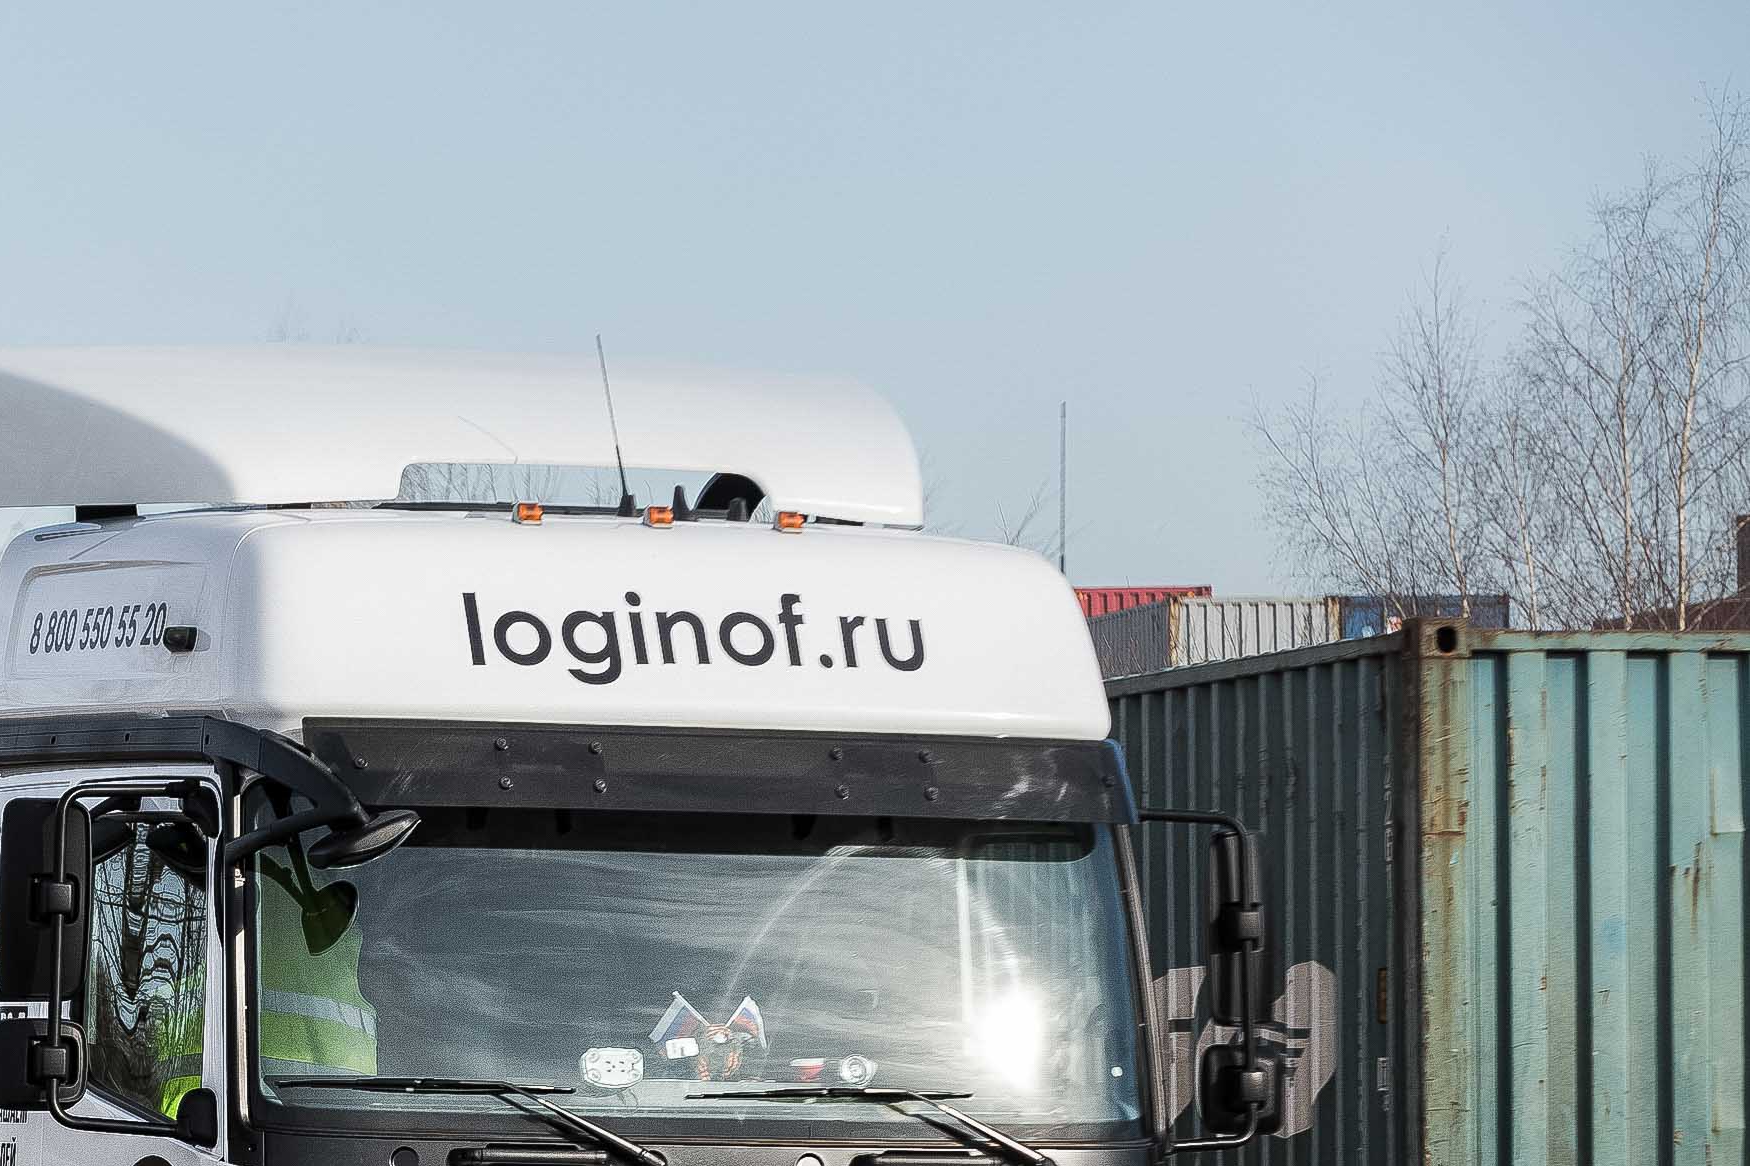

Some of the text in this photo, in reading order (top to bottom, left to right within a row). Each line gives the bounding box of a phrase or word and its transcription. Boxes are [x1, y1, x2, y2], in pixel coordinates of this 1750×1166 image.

[29, 602, 167, 654] 8 800 550 55 20
[462, 591, 926, 685] loginof.ru
